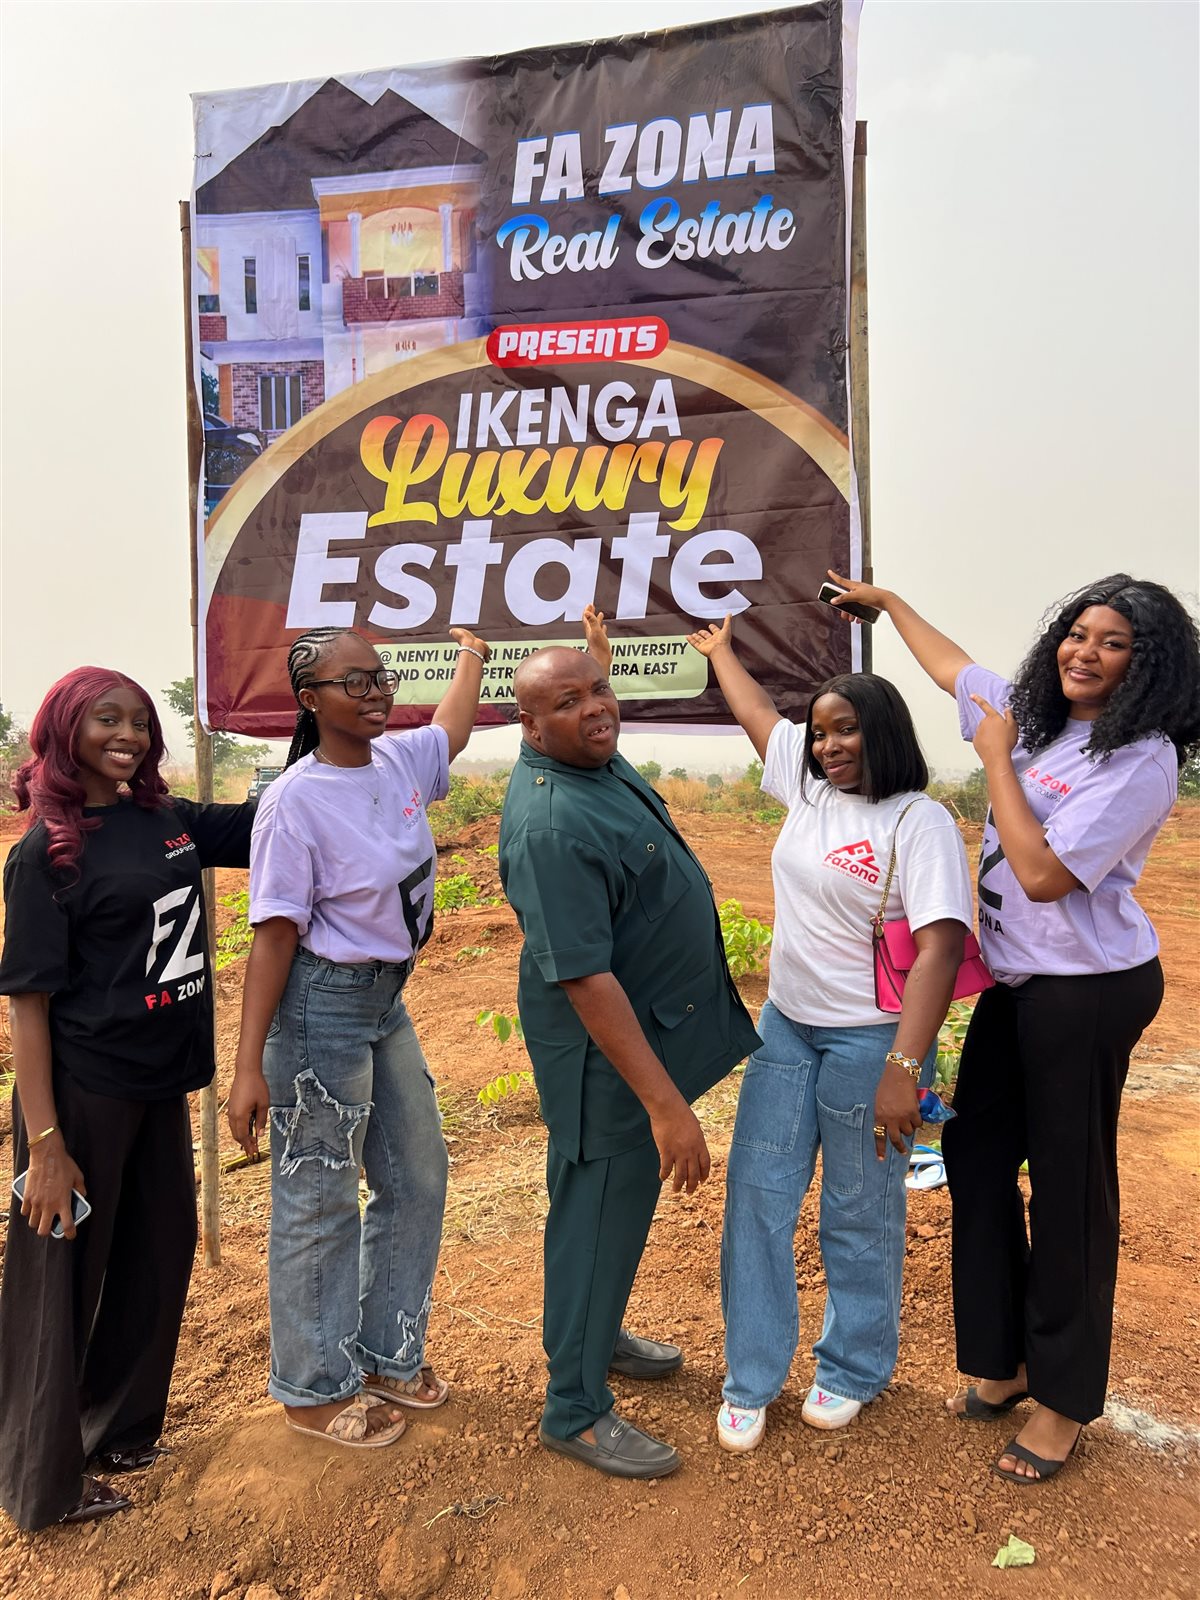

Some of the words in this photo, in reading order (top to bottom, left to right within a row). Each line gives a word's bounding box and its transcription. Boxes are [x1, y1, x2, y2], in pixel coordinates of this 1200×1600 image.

[511, 131, 585, 206] FA
[598, 103, 776, 198] ZONA
[496, 213, 622, 281] Real
[635, 195, 797, 269] Estate
[497, 325, 658, 360] PRESENTS
[456, 378, 682, 449] IKENGA
[360, 413, 724, 531] Luxury
[285, 511, 763, 629] Estate
[396, 650, 438, 662] NENYI
[398, 669, 419, 681] ND
[643, 662, 678, 675] EAST
[1024, 767, 1040, 779] FA
[145, 990, 172, 1010] FA
